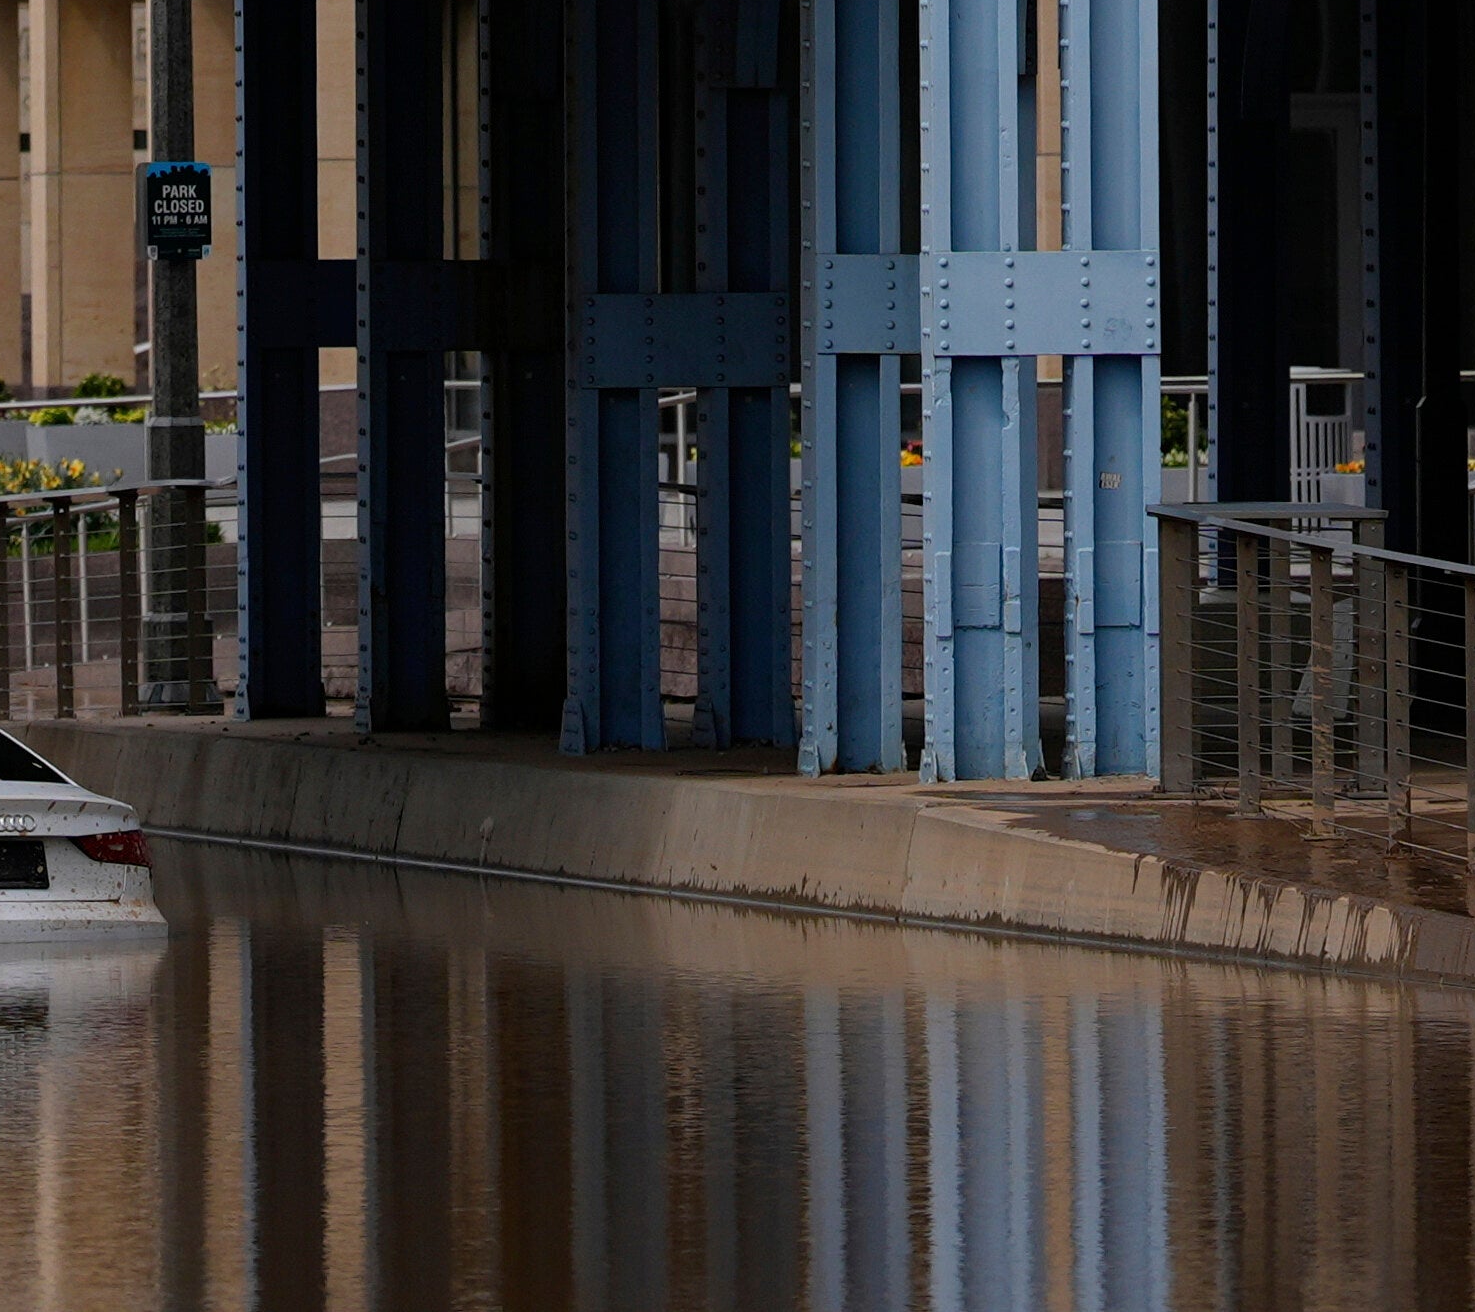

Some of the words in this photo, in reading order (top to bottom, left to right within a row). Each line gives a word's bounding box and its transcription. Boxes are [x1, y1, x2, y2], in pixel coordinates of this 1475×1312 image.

[162, 184, 197, 198] PARK
[154, 199, 205, 214] CLOSED
[151, 215, 161, 225] 11
[163, 215, 178, 225] PM
[185, 215, 192, 224] 6
[193, 215, 208, 225] AM
